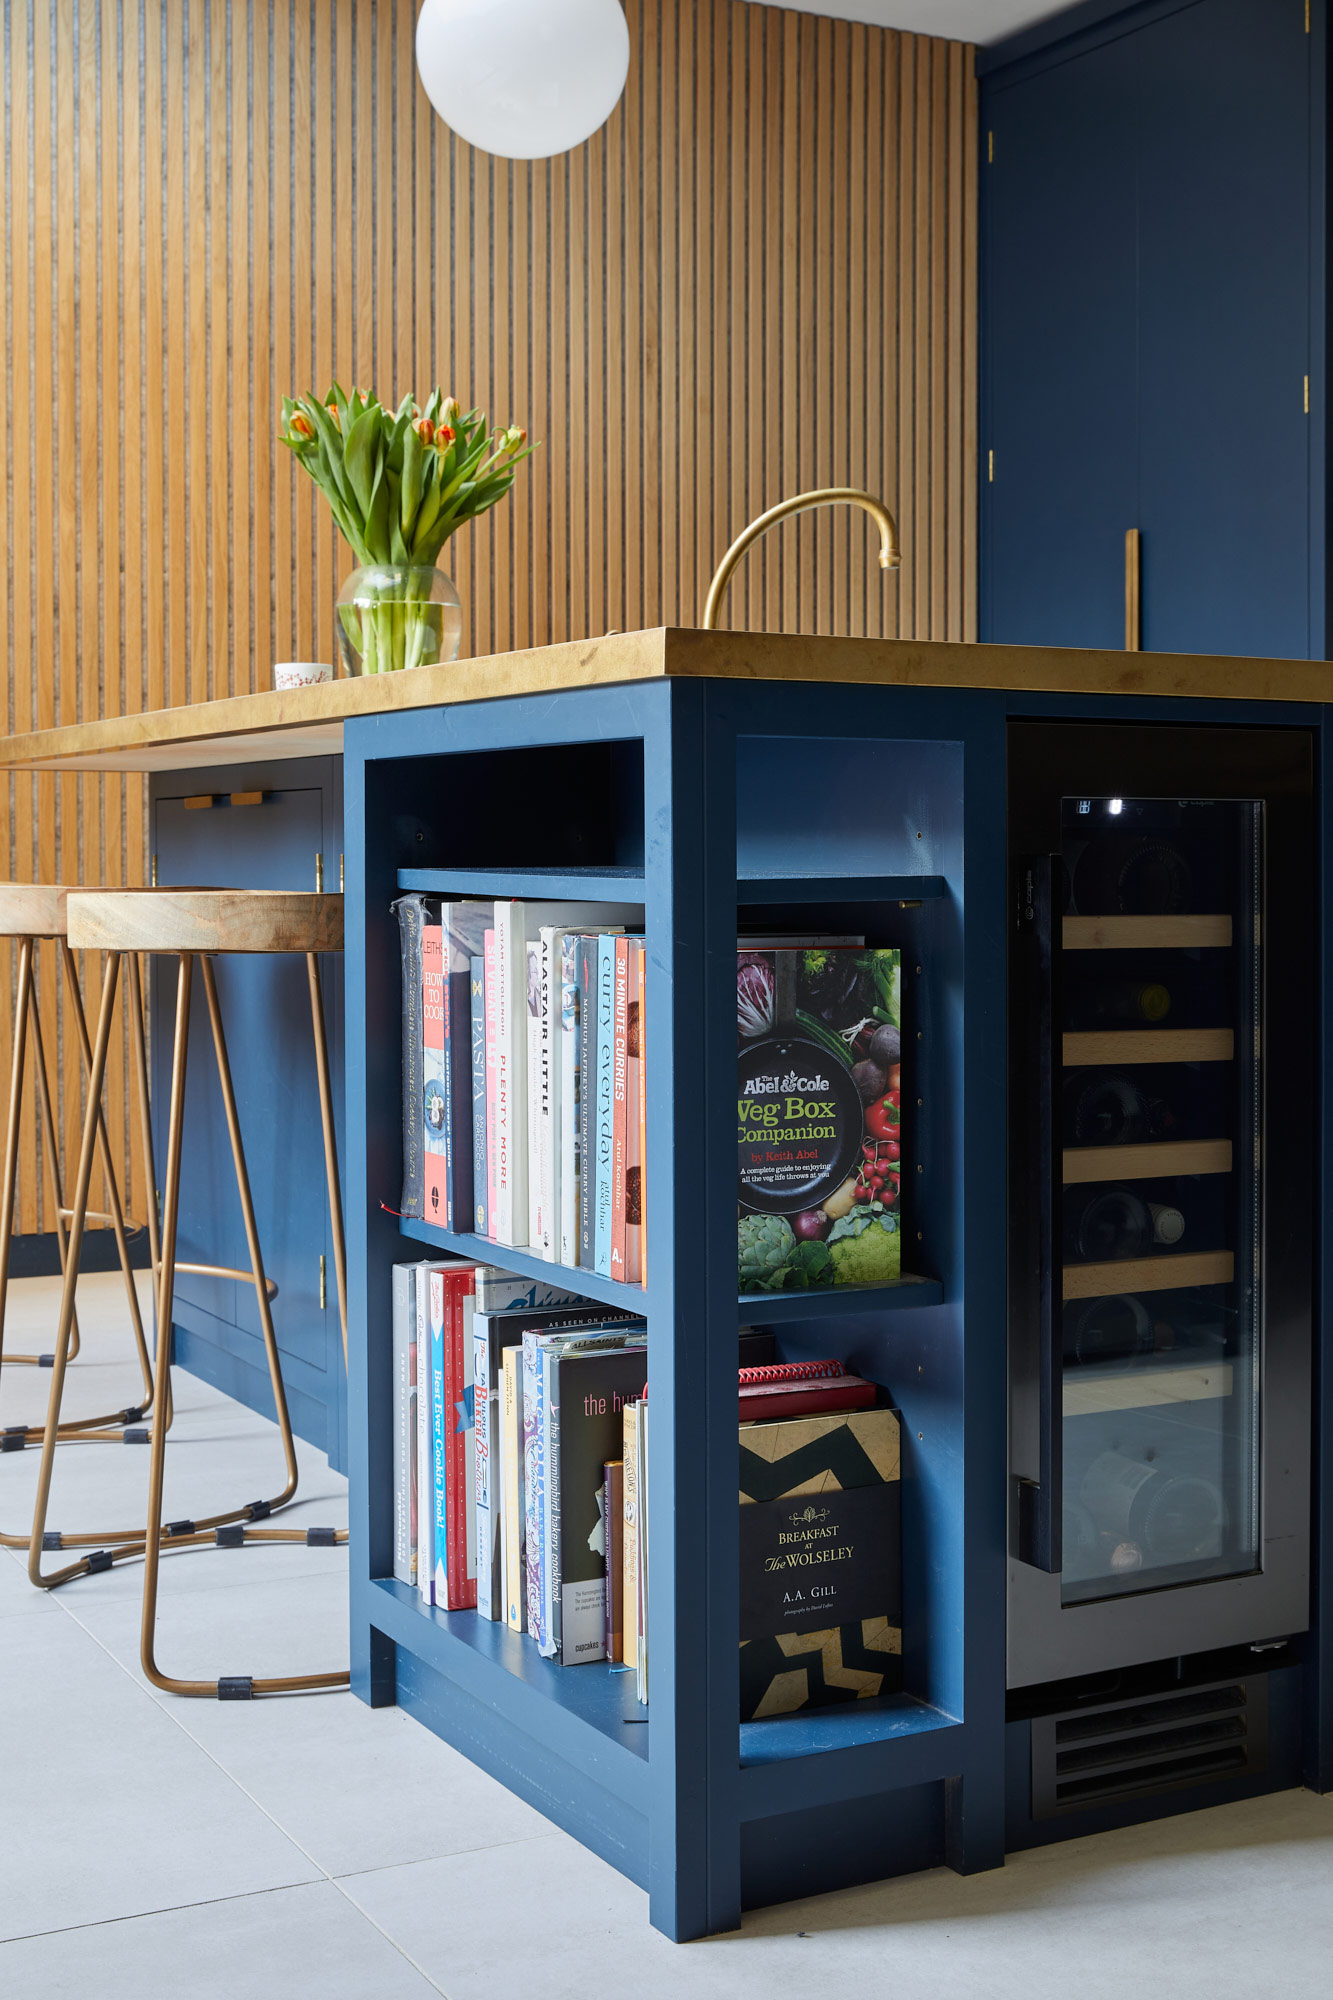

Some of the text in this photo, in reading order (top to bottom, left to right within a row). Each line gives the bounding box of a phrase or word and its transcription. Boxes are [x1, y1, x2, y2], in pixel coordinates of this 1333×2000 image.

[406, 908, 417, 937] Delia
[488, 944, 496, 966] SO
[425, 972, 443, 987] HOW
[407, 982, 416, 1031] Complete
[429, 989, 439, 1003] TO
[488, 970, 497, 1022] VEGAN
[424, 1004, 444, 1020] COOK
[615, 957, 625, 1101] 30 MINUTE CURRIES
[472, 1015, 484, 1103] PASTA
[598, 955, 613, 1173] curry everyday
[744, 1072, 829, 1095] Abel & Cole
[407, 1095, 417, 1137] Cookery
[738, 1097, 836, 1127] Veg Box
[747, 1166, 775, 1175] complete
[776, 1165, 794, 1174] guide
[802, 1163, 831, 1171] enjoying
[751, 1148, 818, 1165] by Keith Abel
[742, 1175, 750, 1183] all
[763, 1175, 774, 1183] veg
[775, 1173, 785, 1181] life
[786, 1172, 809, 1180] throws
[817, 1172, 830, 1180] you
[599, 1180, 607, 1233] kochhar
[562, 1319, 583, 1327] SEEN
[571, 1336, 627, 1349] ALLSAINTS
[401, 1387, 406, 1400] TO
[418, 1358, 427, 1434] chocolate
[584, 1393, 606, 1416] the
[475, 1384, 486, 1436] BAKER
[536, 1373, 545, 1496] MAGNOLIA
[434, 1369, 444, 1529] Best Ever Cookie Book!
[475, 1438, 488, 1501] Brothers
[625, 1457, 636, 1494] BEETON'S
[551, 1422, 562, 1604] the hummingbird bakery cookbook
[779, 1525, 839, 1545] BREAKFAST
[804, 1542, 813, 1550] AT
[764, 1546, 854, 1572] The WOLSELEY
[783, 1586, 837, 1603] A.A. GILL
[575, 1641, 599, 1653] cupcakes
